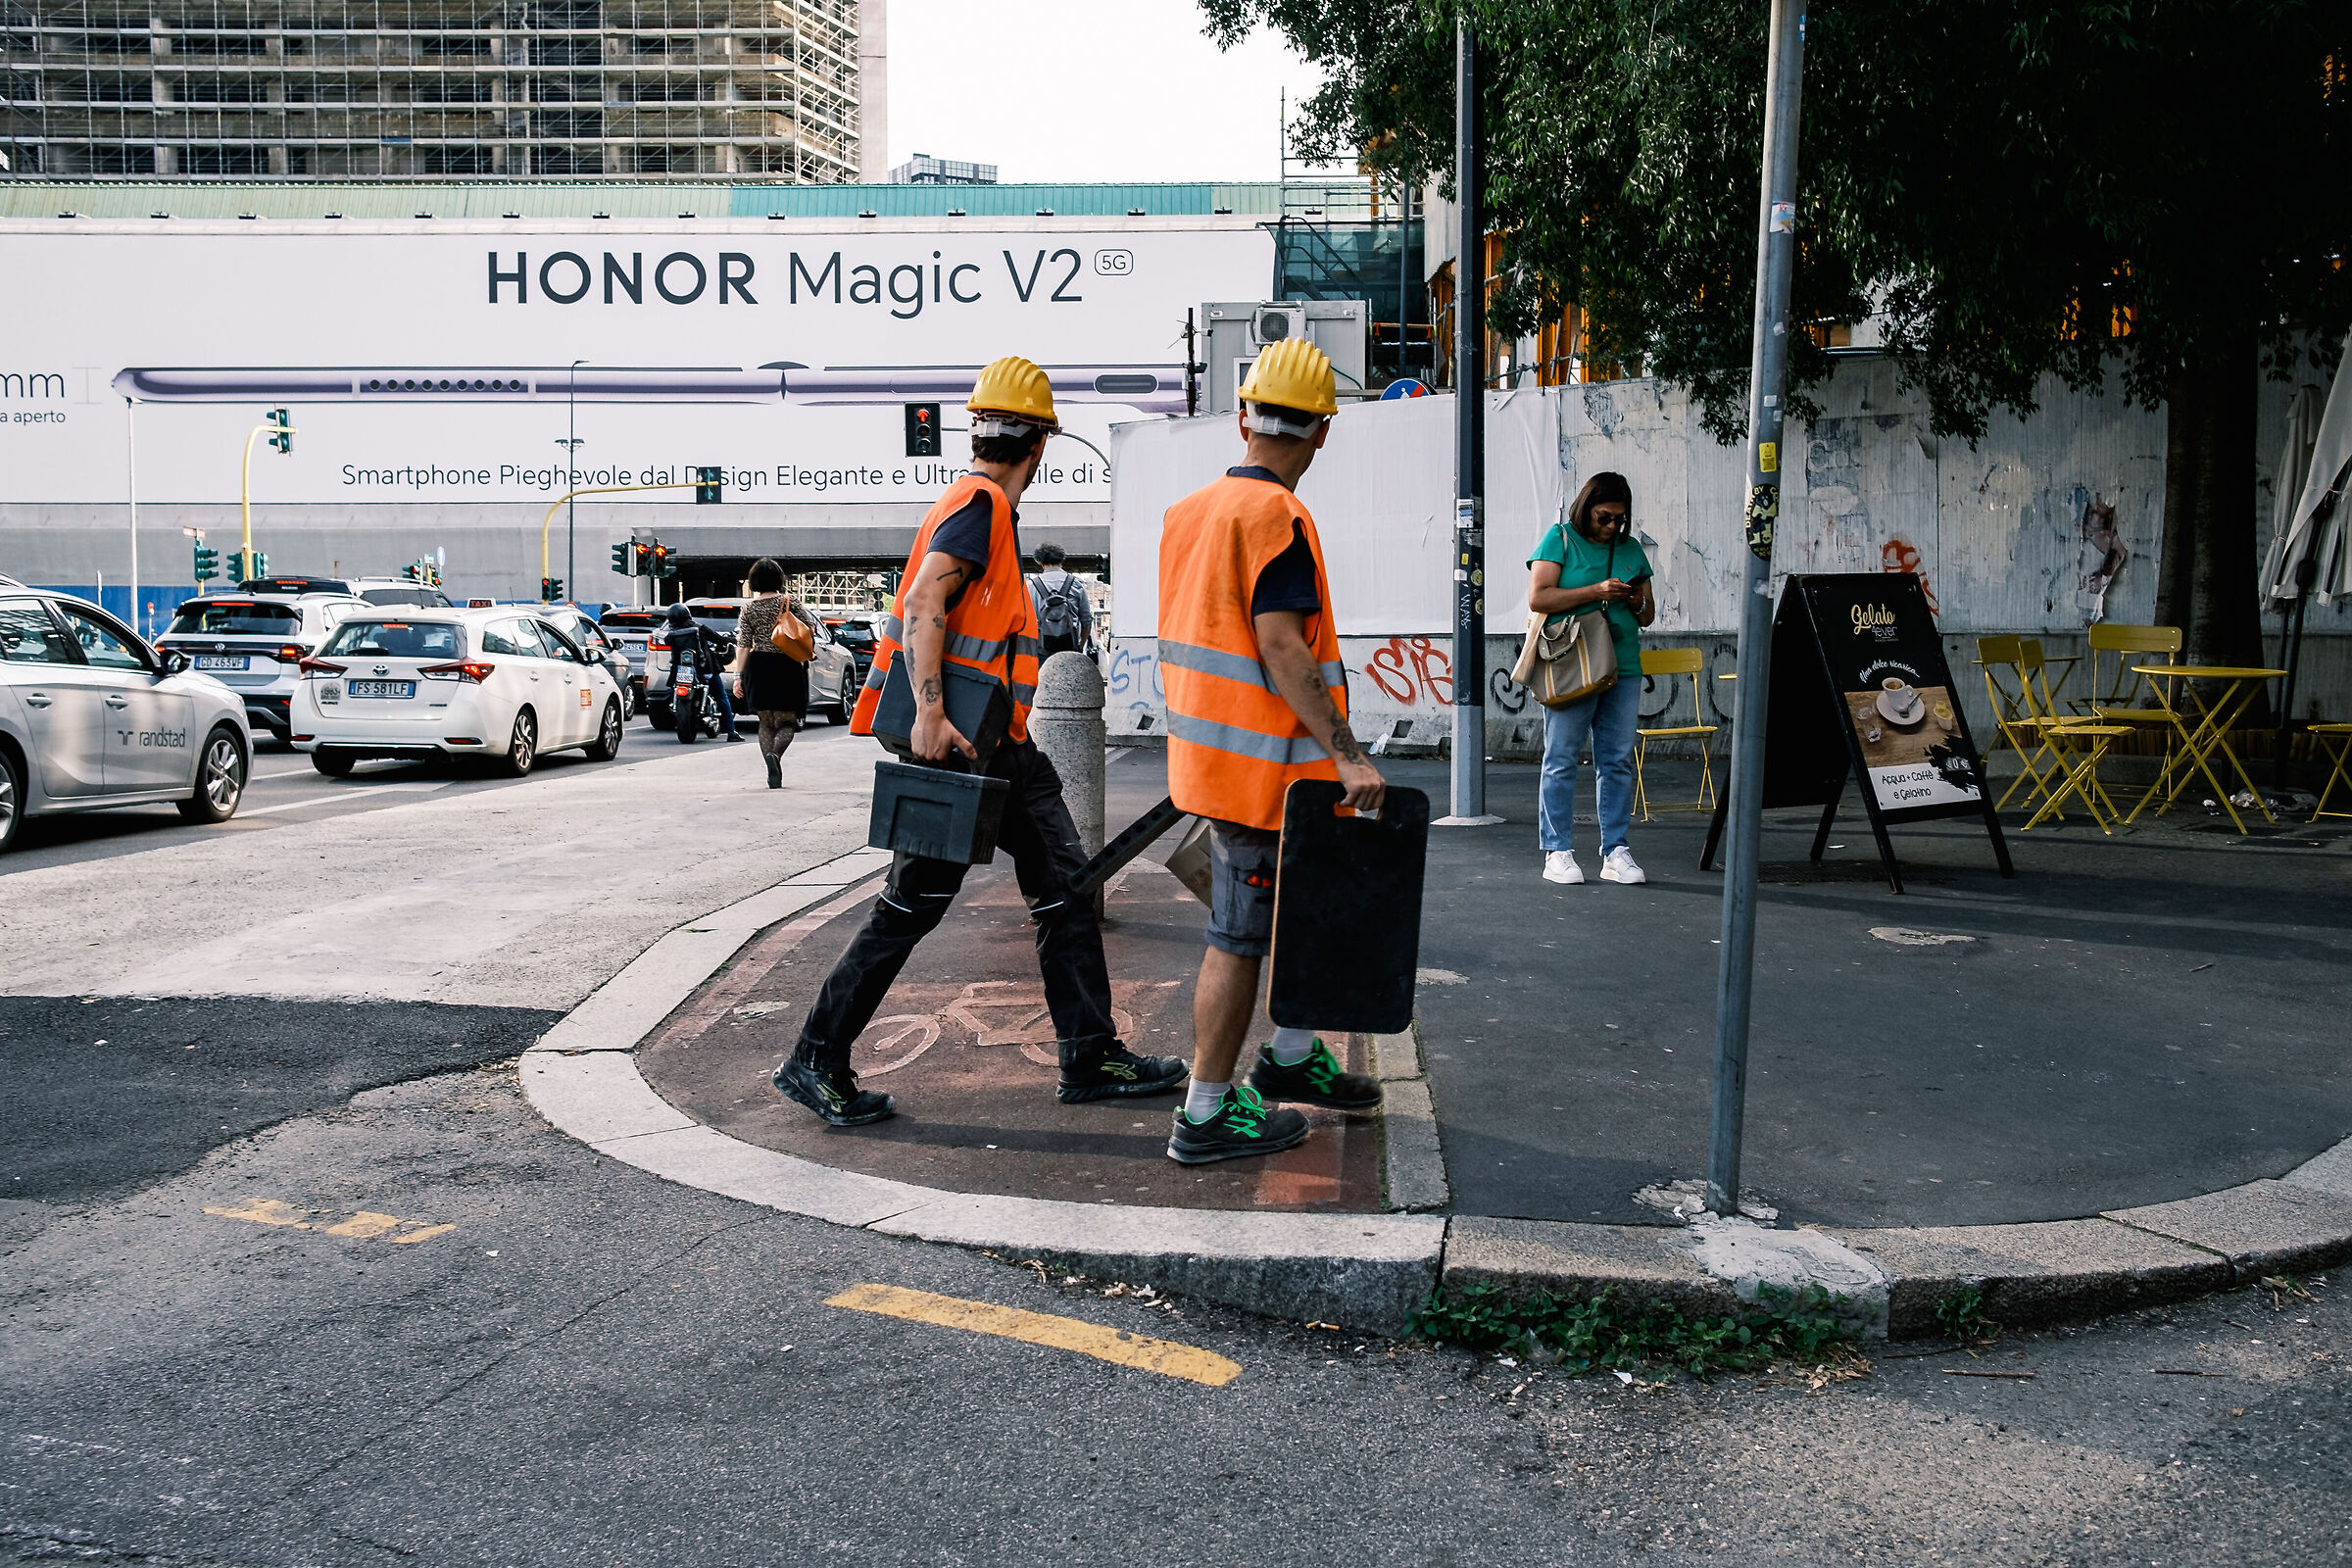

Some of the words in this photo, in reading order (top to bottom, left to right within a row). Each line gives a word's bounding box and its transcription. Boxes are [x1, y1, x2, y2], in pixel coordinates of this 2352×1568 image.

[488, 251, 759, 305] HONOR
[789, 251, 982, 319] Magic
[1003, 248, 1083, 303] V2
[1102, 255, 1127, 270] 5G
[13, 410, 66, 426] aperto
[342, 465, 491, 490] Smartphone
[500, 465, 632, 490] Pieghevole
[640, 465, 675, 486] dal
[686, 466, 767, 491] Dsign
[777, 465, 884, 491] Elegante
[892, 468, 906, 484] e
[1072, 463, 1094, 484] di
[1851, 604, 1895, 635] Gelato
[1872, 626, 1898, 637] 4ever
[1872, 659, 1889, 670] dolce
[357, 682, 370, 694] FS
[373, 682, 407, 695] 581LF
[139, 726, 185, 748] randstad
[1882, 774, 1906, 786] Acqua
[1893, 791, 1900, 800] e
[1900, 787, 1932, 801] Gelatino
